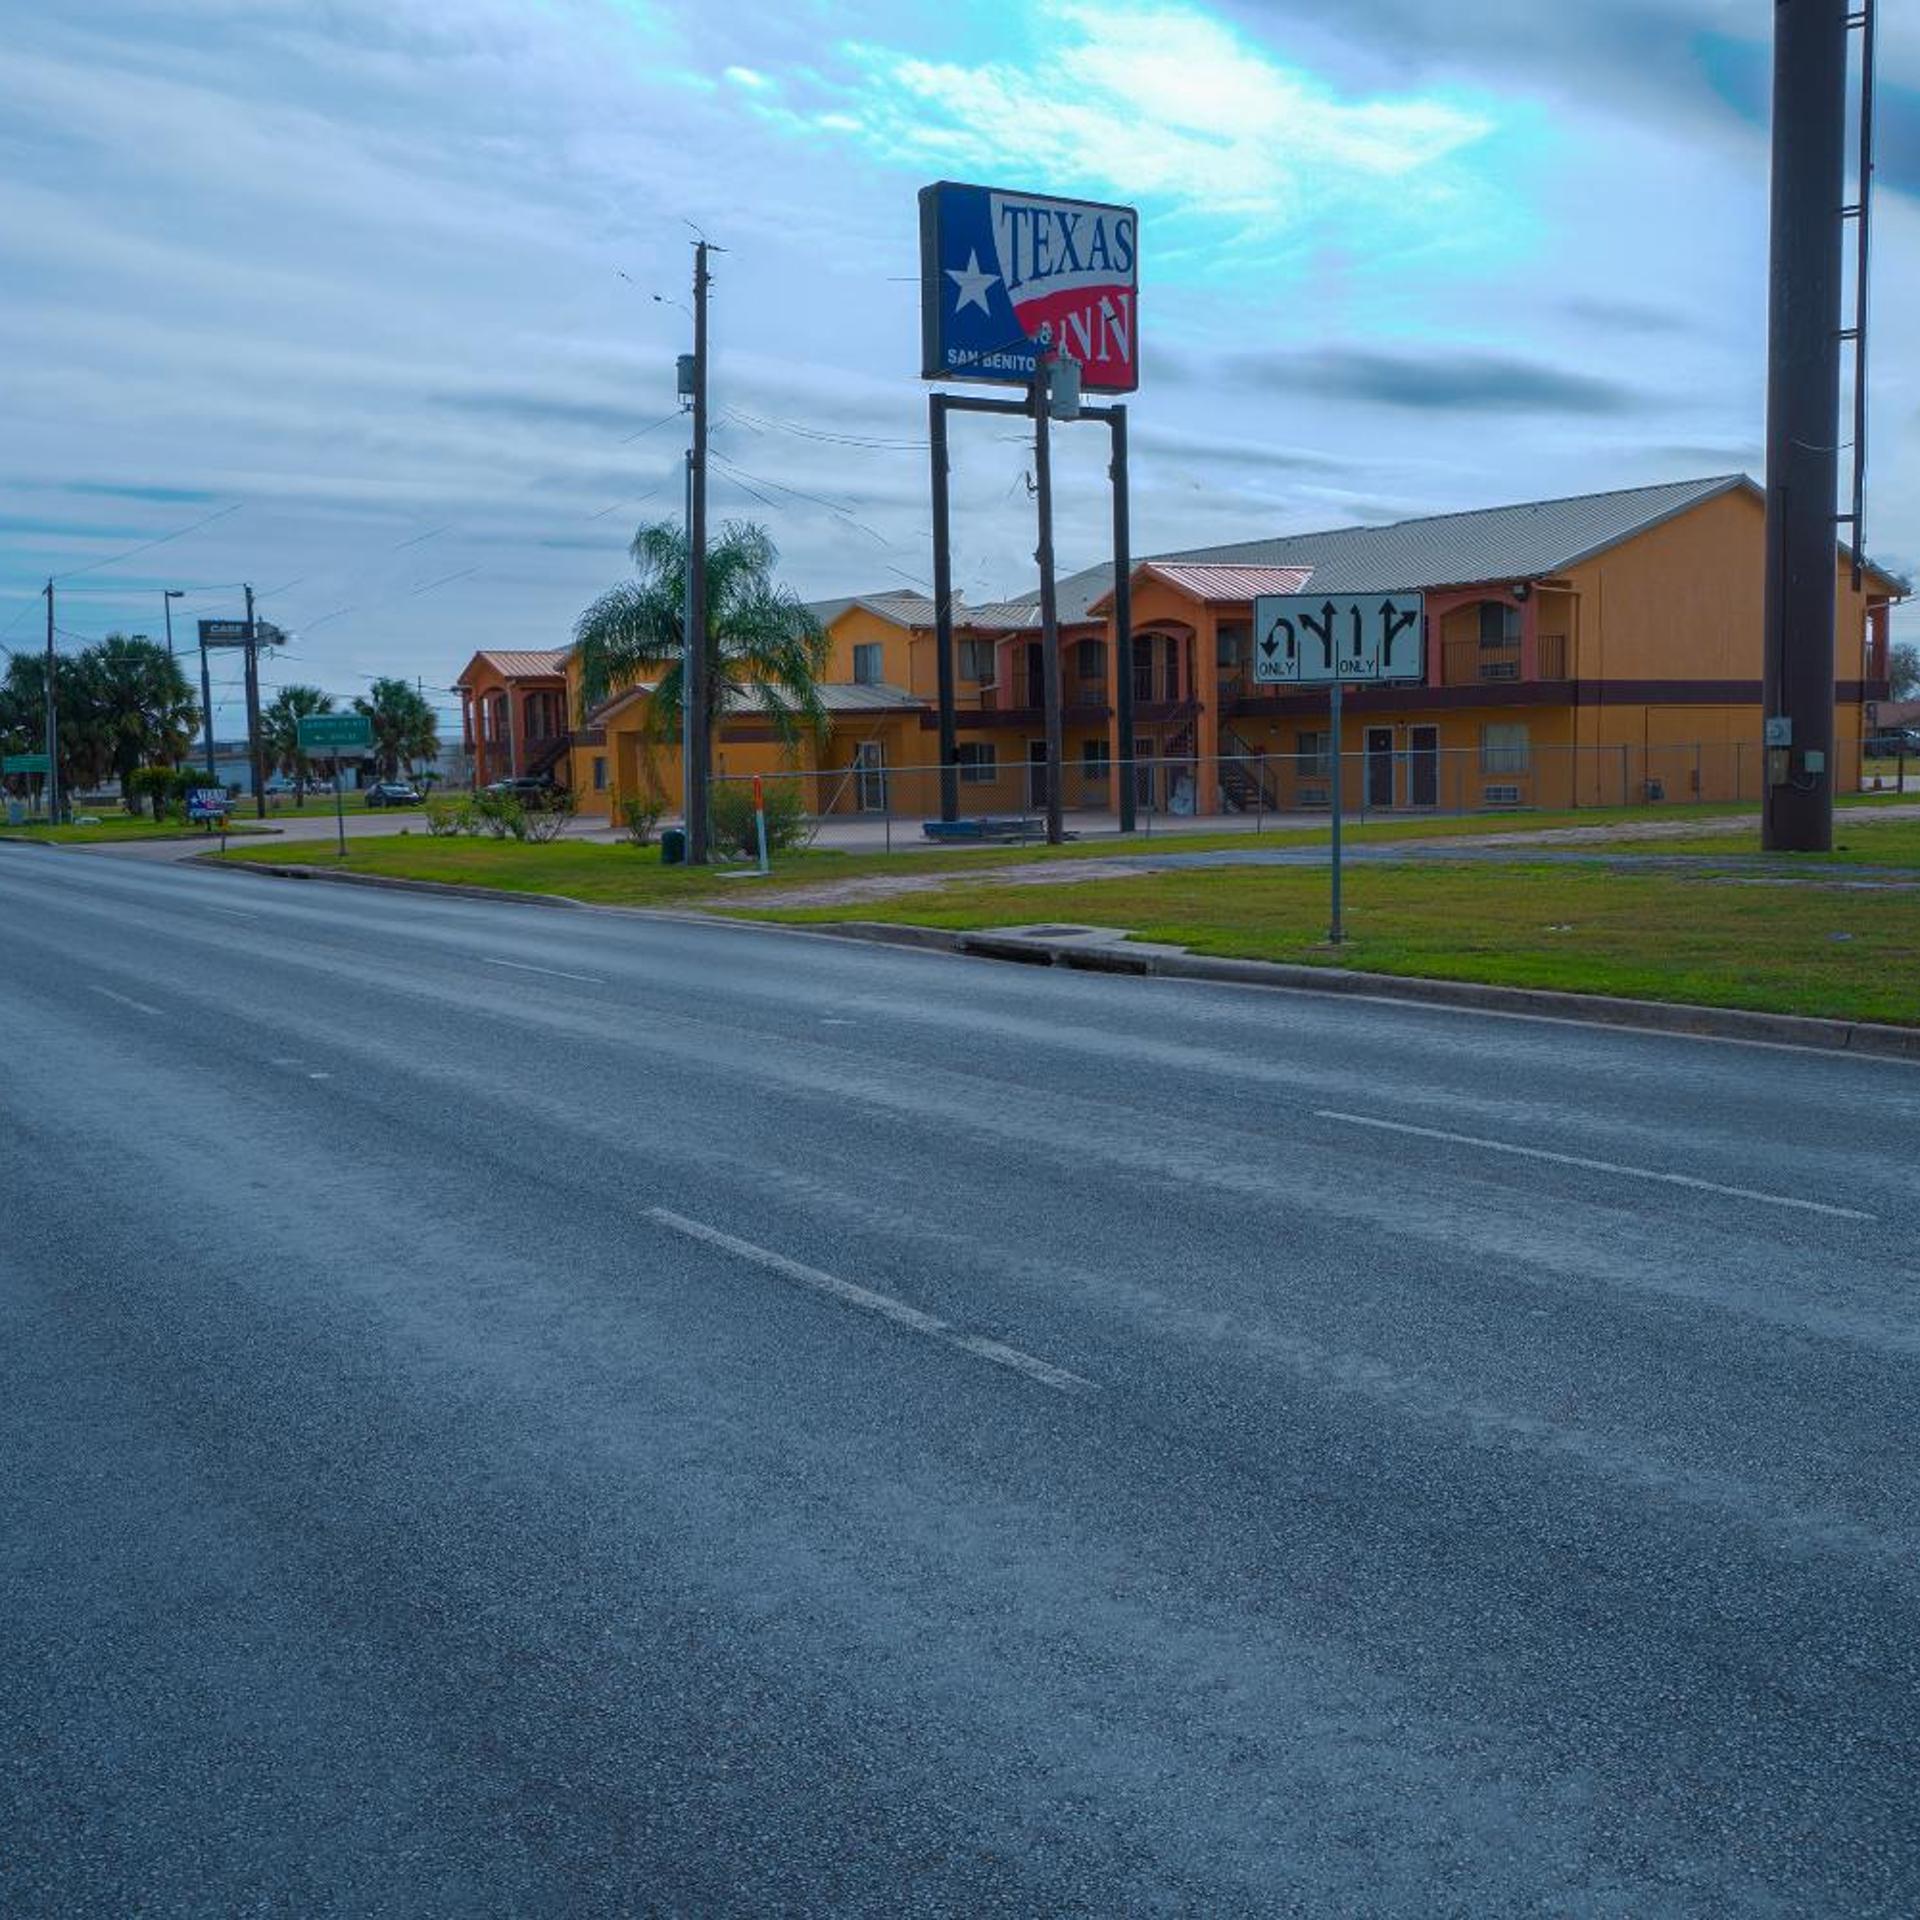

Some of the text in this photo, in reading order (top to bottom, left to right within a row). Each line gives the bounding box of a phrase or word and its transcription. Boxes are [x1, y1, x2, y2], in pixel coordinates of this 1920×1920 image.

[1002, 203, 1132, 291] TEXAS
[948, 349, 1036, 371] SAN BENITO
[1259, 662, 1295, 676] ONLY
[1339, 660, 1375, 674] ONLY
